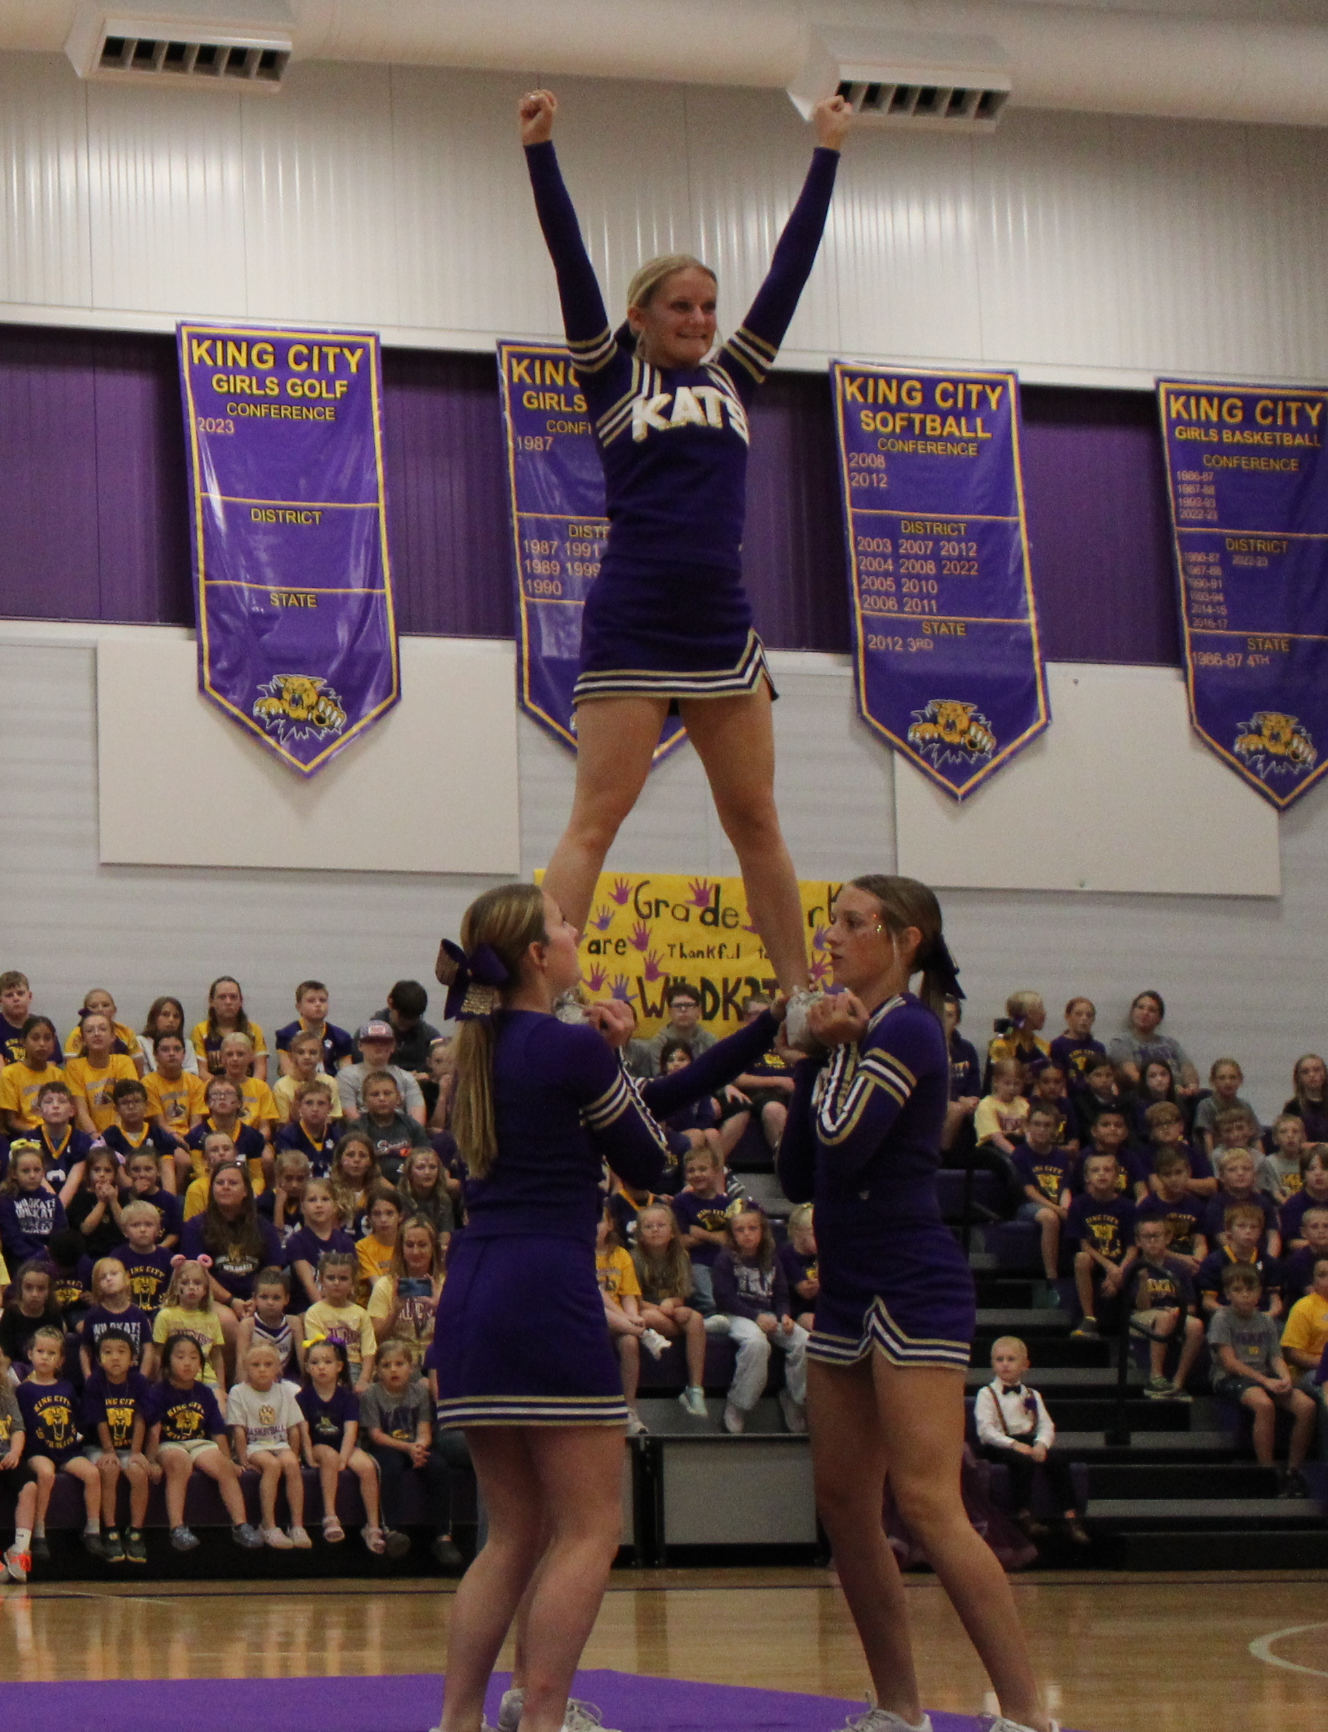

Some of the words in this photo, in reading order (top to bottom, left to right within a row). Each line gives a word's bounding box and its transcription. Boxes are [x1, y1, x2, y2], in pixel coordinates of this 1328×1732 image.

[191, 339, 275, 369] KING
[287, 344, 365, 373] CITY
[211, 374, 280, 396] GIRLS
[286, 378, 348, 399] GOLF
[844, 376, 923, 406] KING
[935, 382, 1003, 411] CITY
[523, 390, 588, 413] GIRLS
[226, 402, 335, 421] CONFERENCE
[631, 386, 749, 444] KATS
[1169, 394, 1243, 423] KING
[1255, 400, 1323, 427] CITY
[197, 417, 234, 434] 2023
[860, 410, 992, 438] SOFTBALL
[517, 435, 553, 450] 1987
[1175, 426, 1219, 442] GIRLS
[1223, 430, 1322, 447] BASKETBALL
[878, 438, 978, 456] CONFERENCE
[849, 453, 886, 469] 2008
[1203, 454, 1300, 472] CONFERENCE
[851, 473, 888, 488] 2012
[250, 508, 322, 525] DISTRICT
[901, 520, 967, 536] DISTRICT
[524, 539, 558, 555] 1987
[565, 541, 600, 557] 1991
[898, 540, 933, 554] 2007
[940, 542, 978, 557] 2012
[1226, 538, 1288, 553] DISTRICT
[525, 559, 560, 575] 1989
[859, 557, 893, 572] 2004
[942, 561, 978, 575] 2022
[527, 578, 562, 595] 1990
[901, 579, 938, 594] 2010
[270, 593, 317, 608] STATE
[903, 598, 937, 613] 2011
[922, 621, 967, 636] STATE
[868, 636, 903, 650] 2012
[1247, 638, 1290, 652] STATE
[634, 880, 740, 929] Grade
[587, 937, 627, 955] are
[130, 1266, 149, 1275] ING
[150, 1266, 166, 1278] CITY
[34, 1395, 53, 1412] KING
[53, 1394, 72, 1406] CITY
[105, 1398, 118, 1406] ING
[167, 1404, 187, 1416] KING
